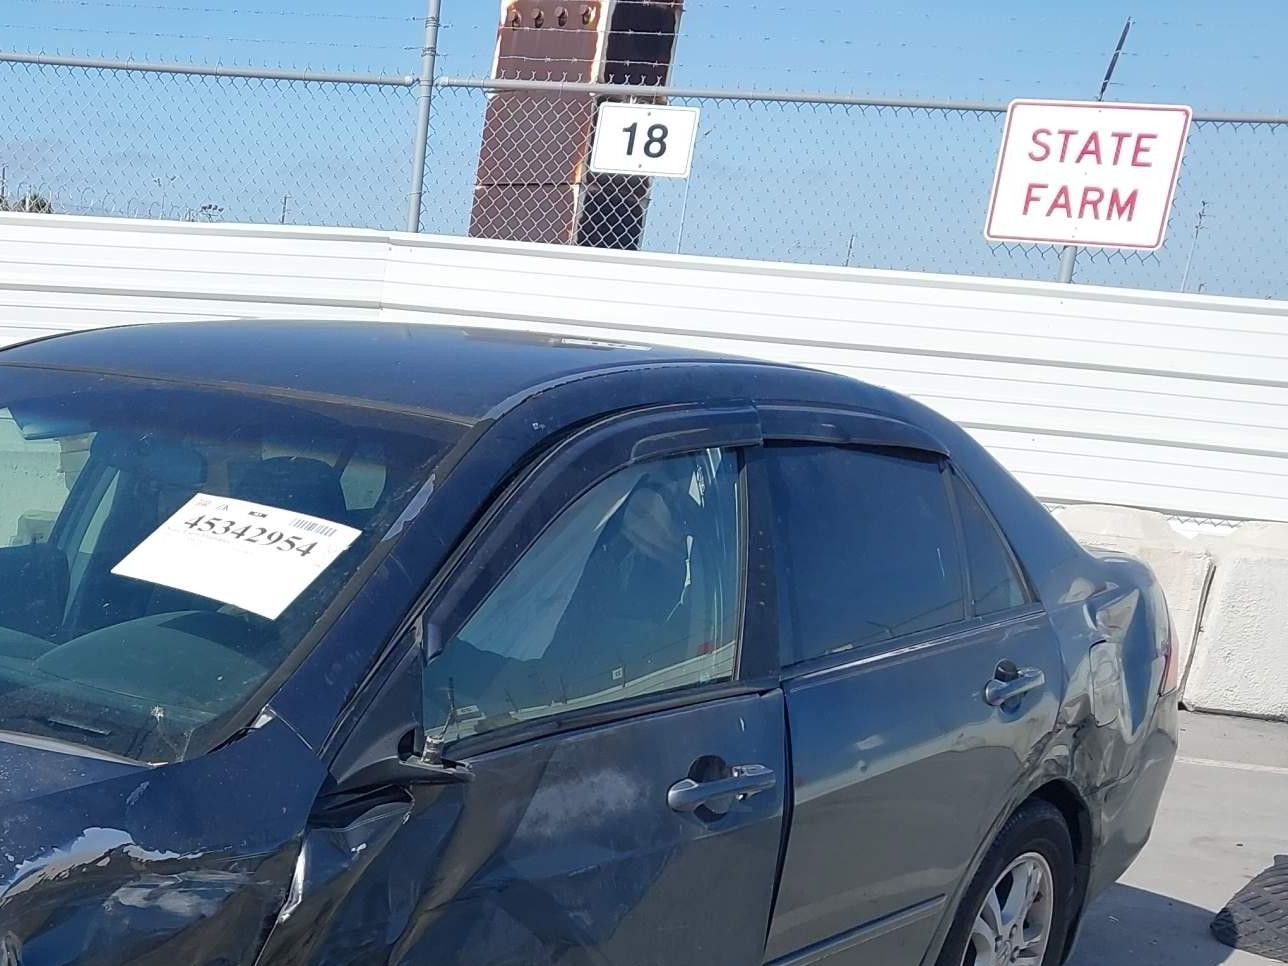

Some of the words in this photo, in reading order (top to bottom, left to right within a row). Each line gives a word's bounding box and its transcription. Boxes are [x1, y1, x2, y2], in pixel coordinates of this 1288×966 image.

[622, 122, 669, 159] 18
[1028, 128, 1158, 168] STATE
[1022, 183, 1138, 222] FARM
[184, 514, 318, 557] 45342954
